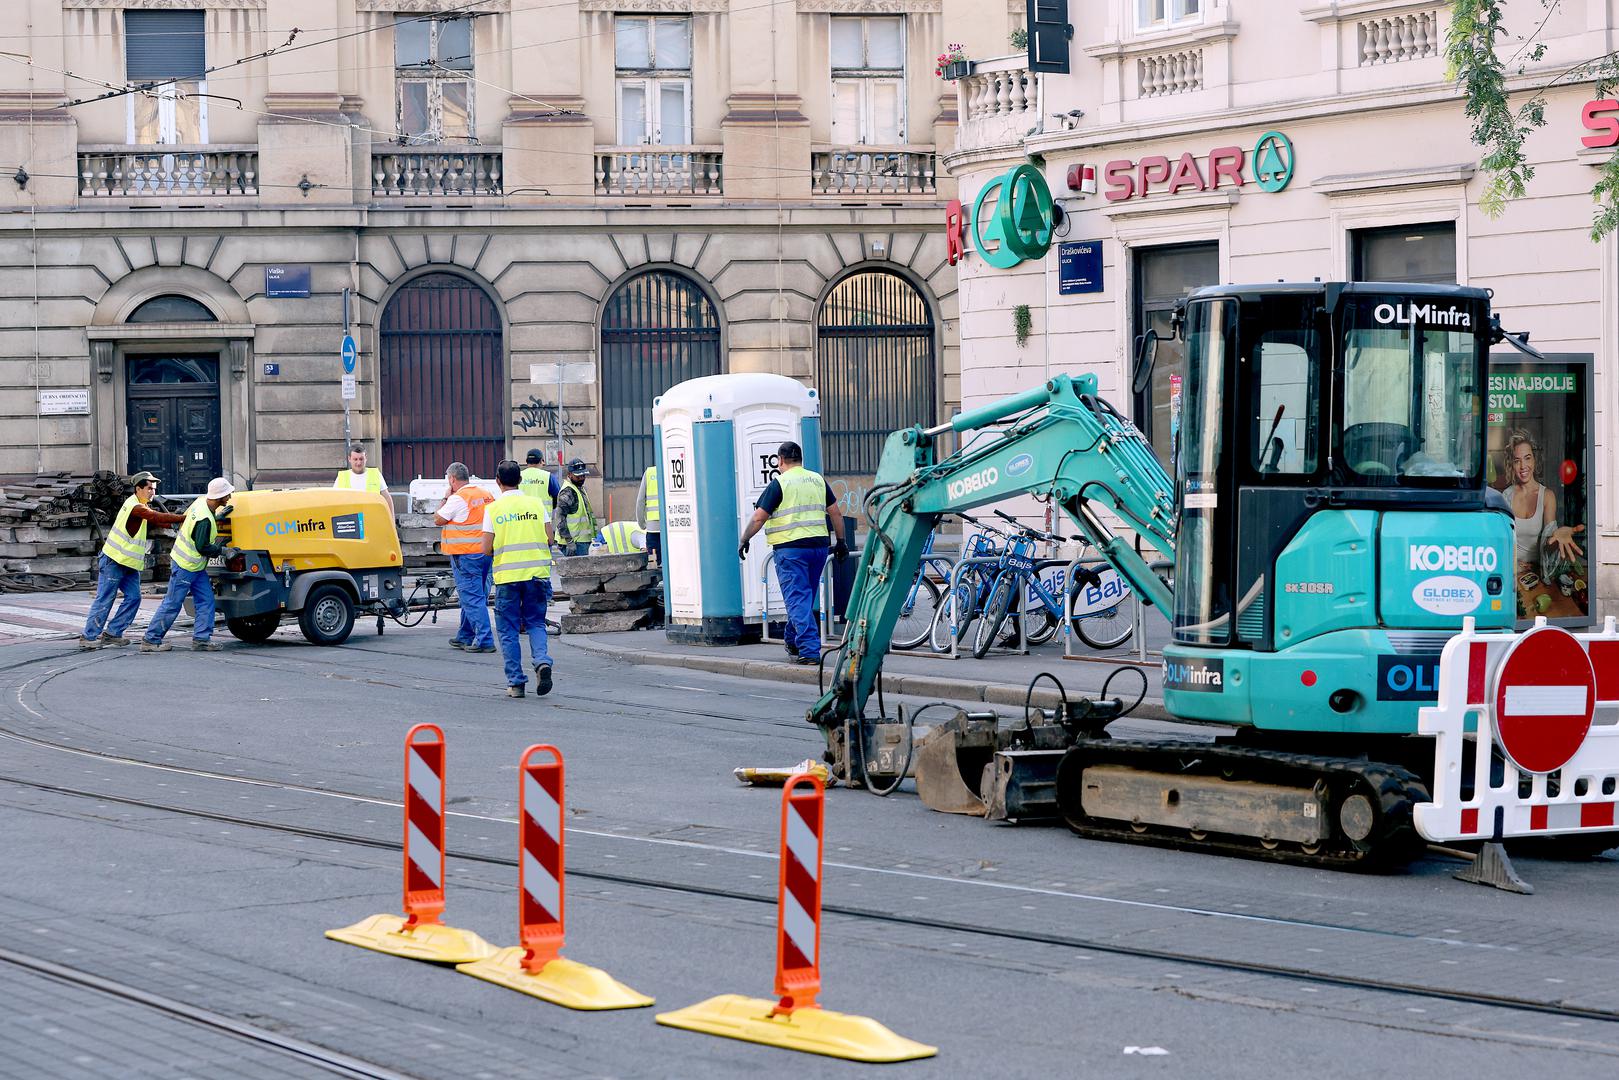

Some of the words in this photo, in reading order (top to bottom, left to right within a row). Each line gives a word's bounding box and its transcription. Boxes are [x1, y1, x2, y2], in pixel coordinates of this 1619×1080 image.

[1104, 146, 1244, 201] SPAR
[1374, 303, 1471, 327] OLMinfra
[1509, 376, 1574, 391] NAJBOLJE
[1488, 394, 1524, 409] STOL.
[760, 454, 779, 469] TO
[672, 474, 685, 488] TOI
[761, 469, 781, 484] TO
[947, 466, 999, 501] KOBELCO
[496, 511, 538, 524] OLMinfra
[265, 519, 325, 536] OLMinfra
[1008, 558, 1033, 570] Bajs
[1410, 544, 1497, 572] KOBELCO
[1423, 588, 1474, 599] GLOBEX
[1168, 661, 1222, 685] OLMinfra
